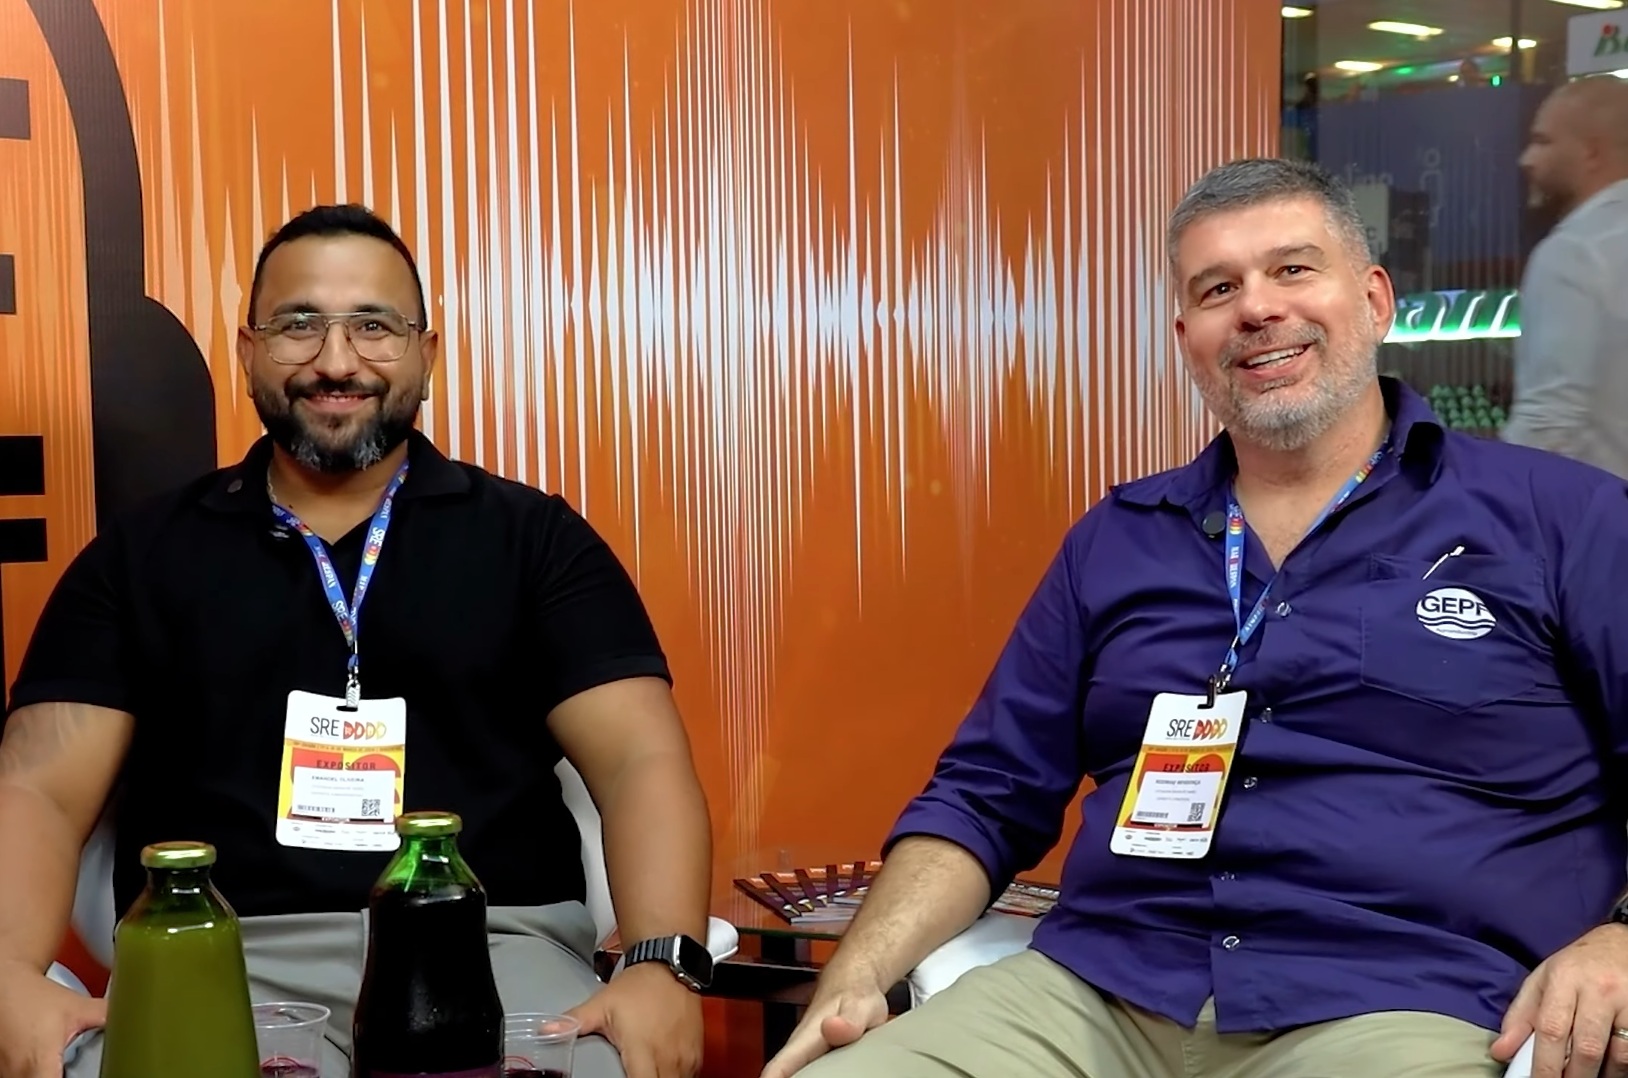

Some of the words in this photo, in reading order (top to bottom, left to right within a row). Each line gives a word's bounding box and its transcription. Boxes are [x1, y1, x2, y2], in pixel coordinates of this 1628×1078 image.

[367, 527, 384, 547] SRE
[330, 600, 348, 622] SRE
[310, 716, 340, 737] SRE
[1166, 718, 1195, 738] SRE
[316, 759, 376, 771] EXPOSITOR
